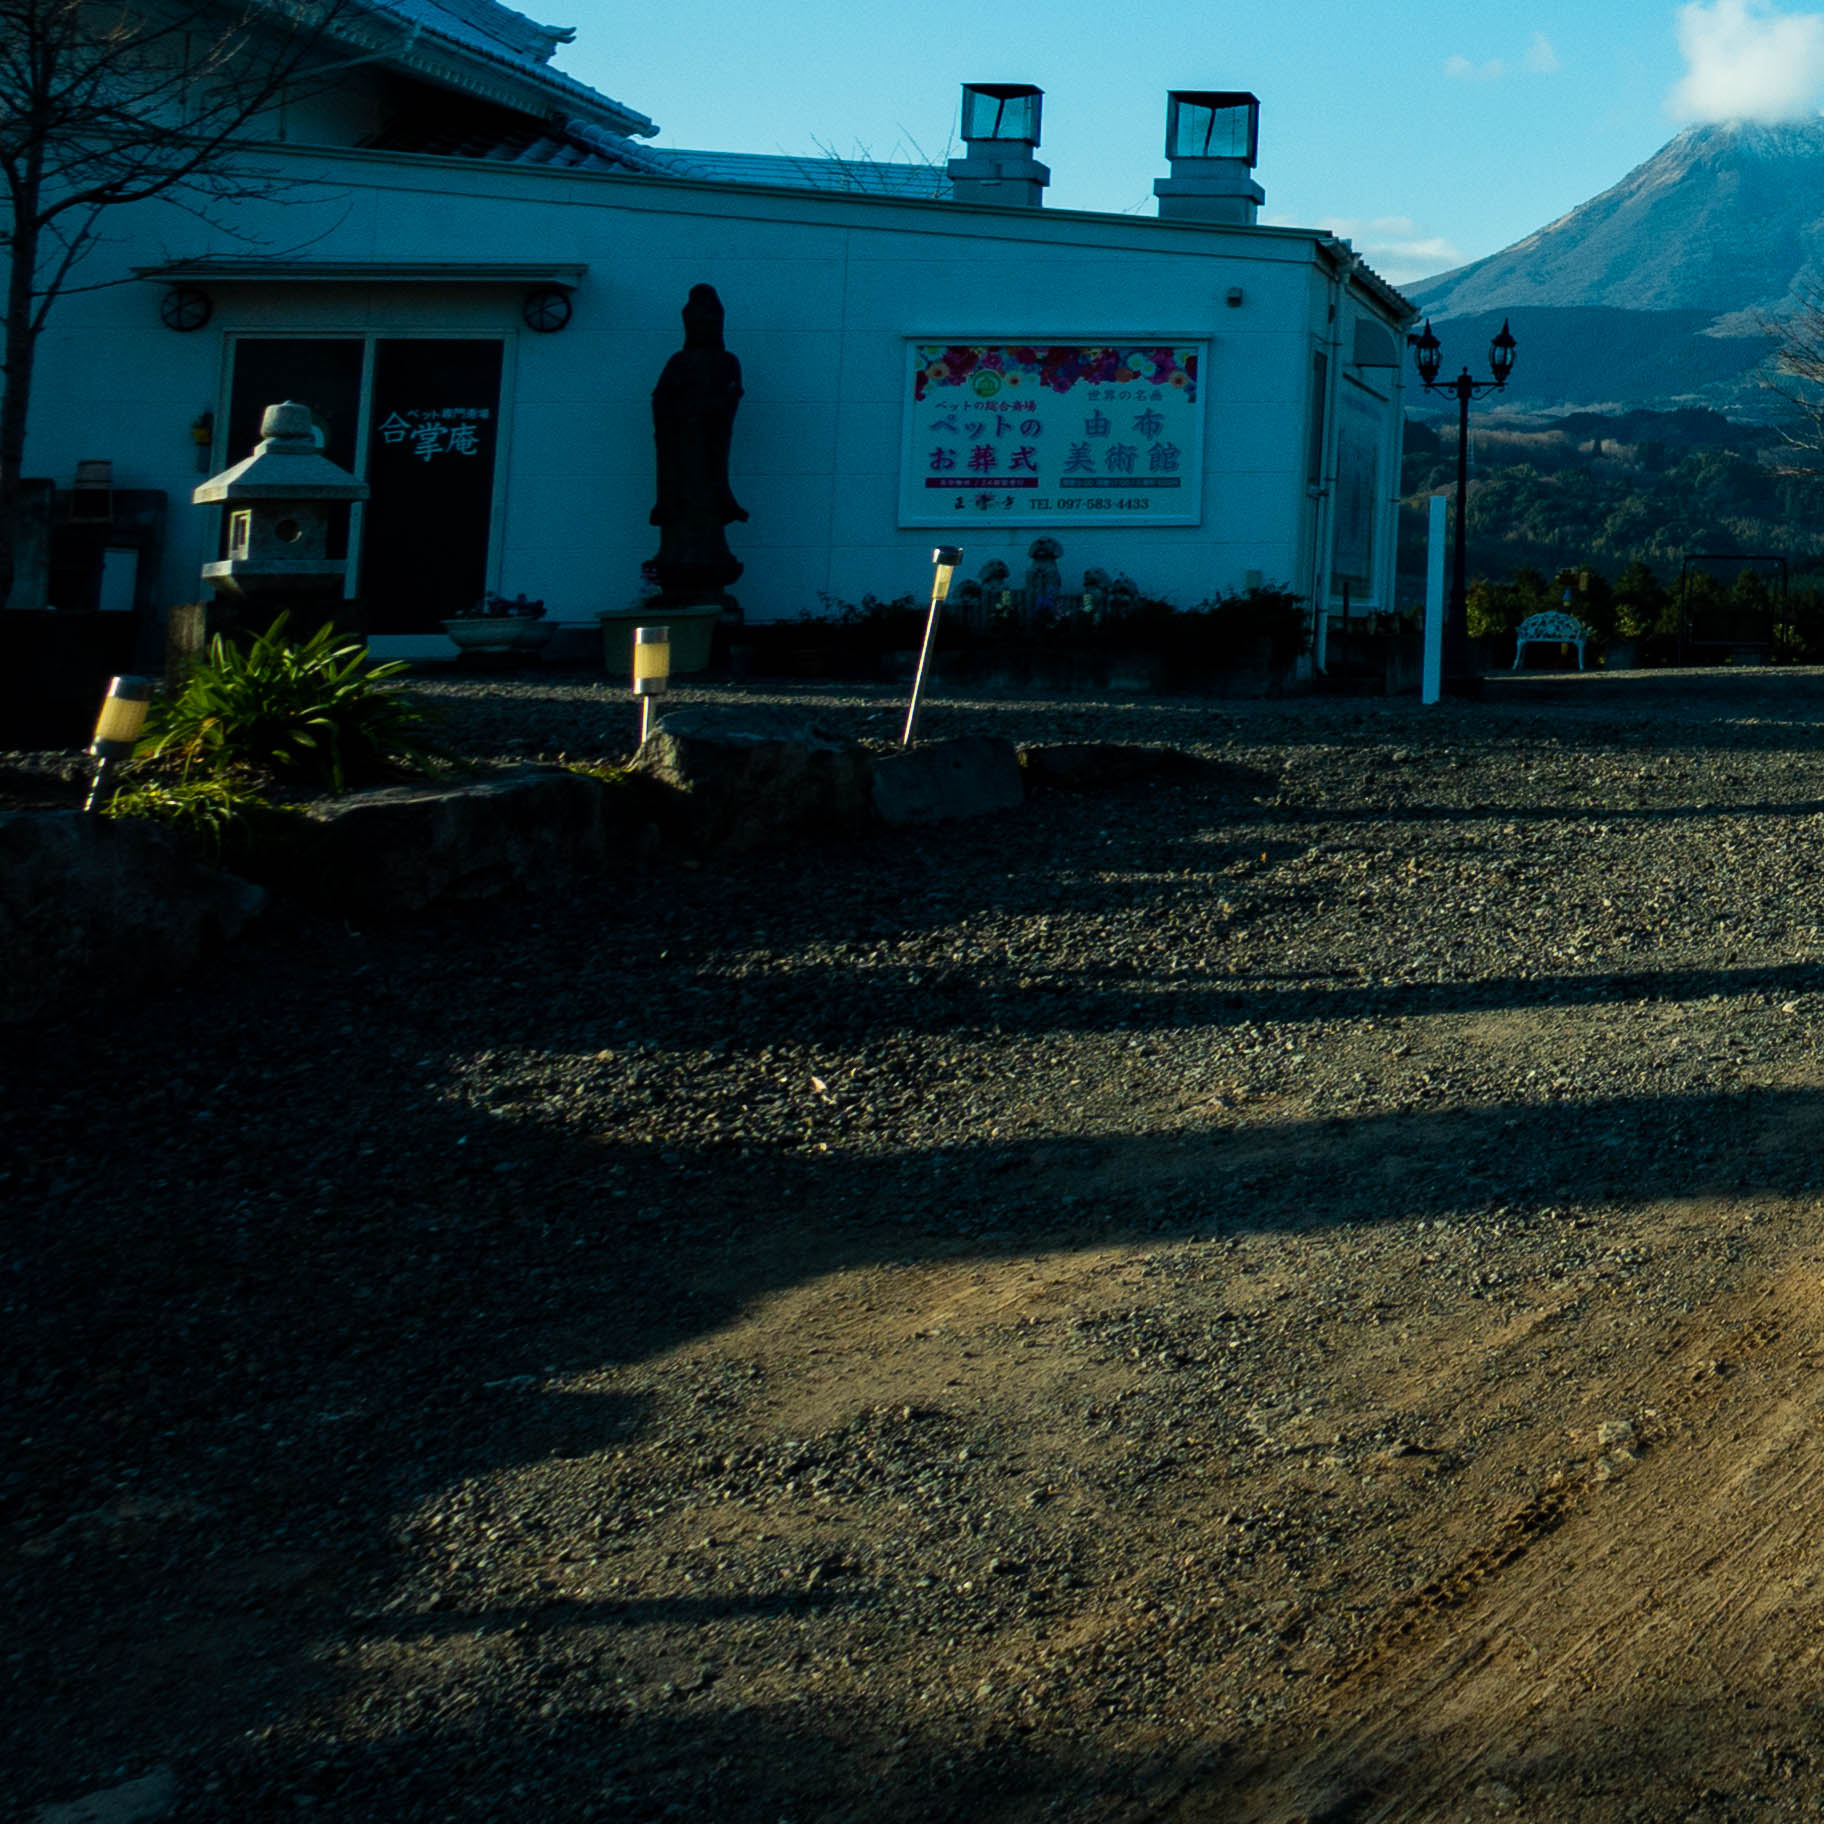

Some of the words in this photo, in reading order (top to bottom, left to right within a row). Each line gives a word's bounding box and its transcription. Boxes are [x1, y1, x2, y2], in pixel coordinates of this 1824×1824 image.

[1087, 389, 1164, 401] 世界の名画
[377, 410, 480, 462] 合掌庵
[929, 414, 1042, 440] ペットの
[1083, 408, 1165, 440] 由布
[929, 443, 1038, 472] お葬式
[1062, 441, 1181, 474] 美術館
[1057, 498, 1150, 511] 097-583-4433
